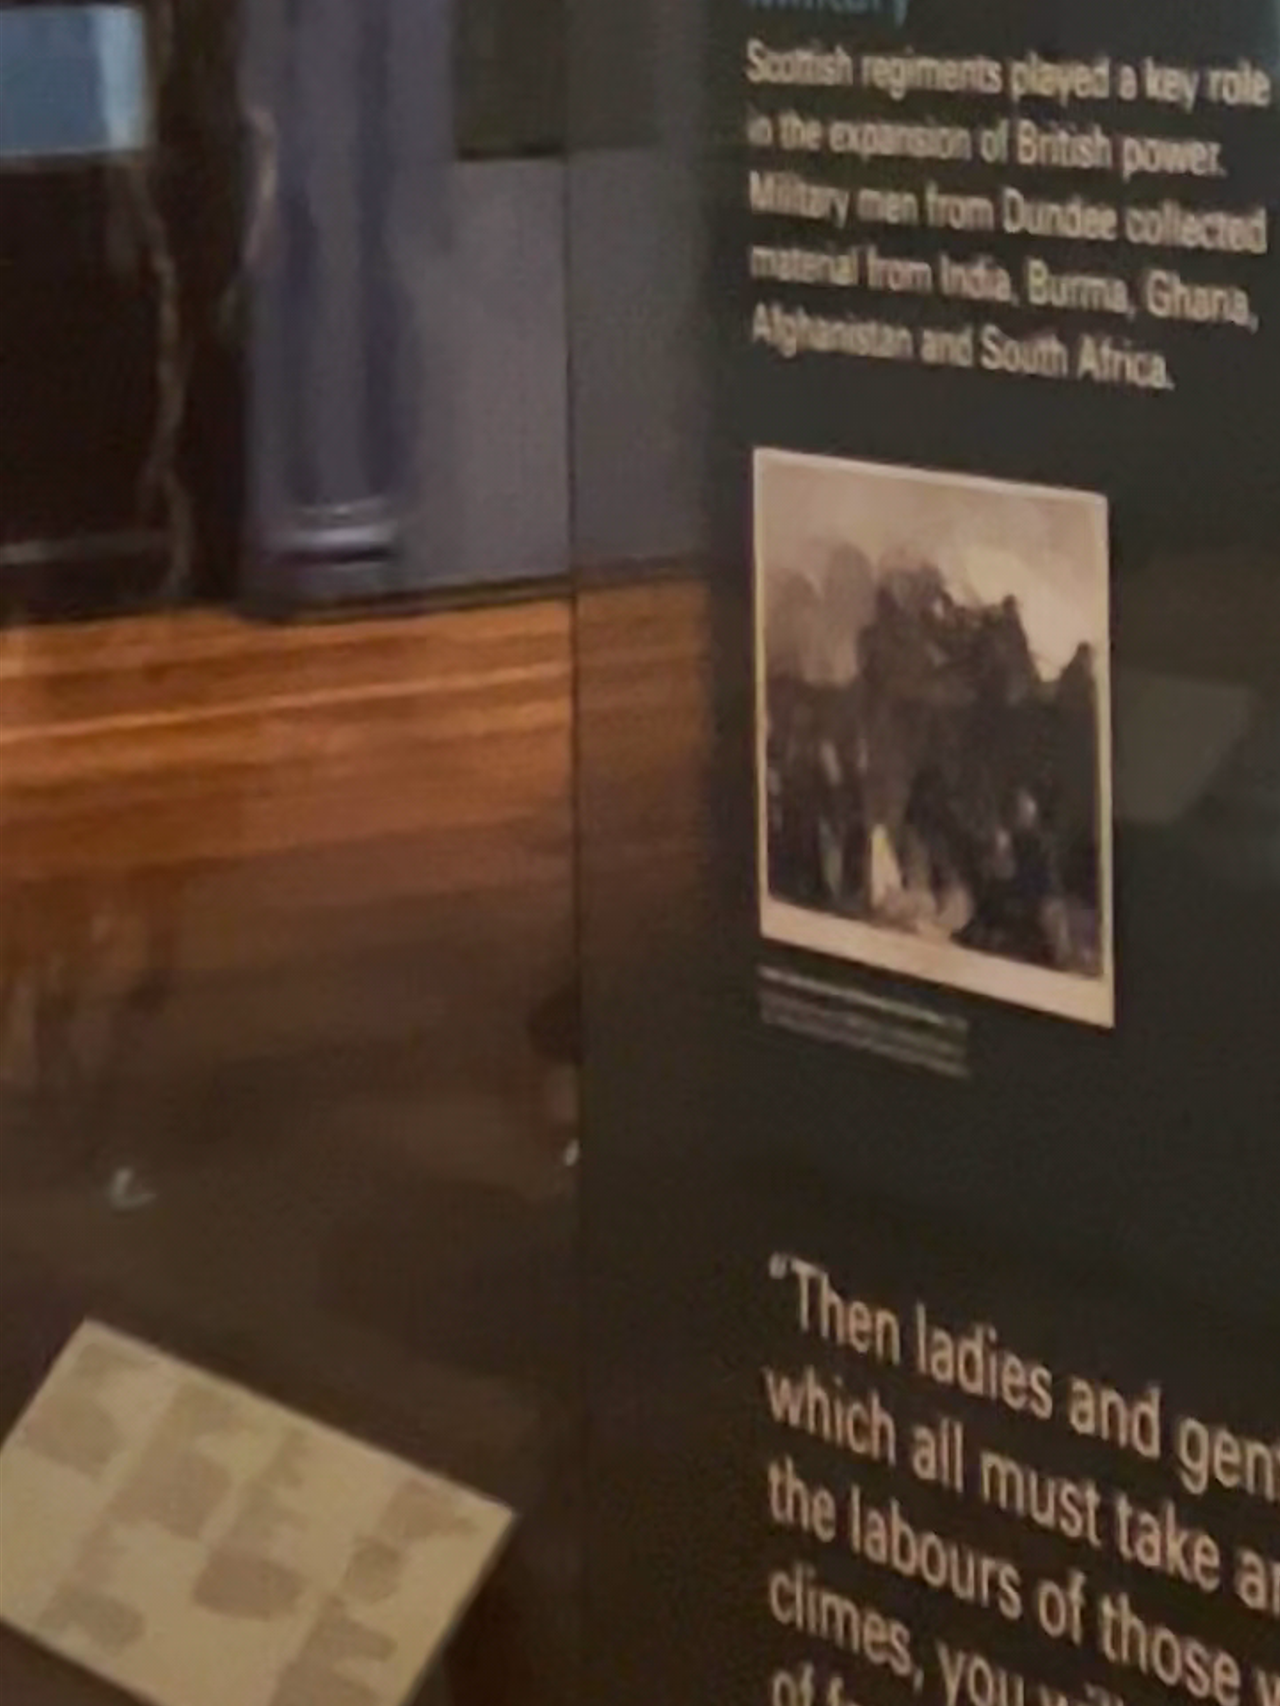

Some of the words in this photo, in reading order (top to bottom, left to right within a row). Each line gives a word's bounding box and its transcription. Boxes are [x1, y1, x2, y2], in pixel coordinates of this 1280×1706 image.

[746, 39, 853, 85] Scottish
[862, 49, 1001, 99] regiments
[1011, 51, 1109, 105] played
[1118, 65, 1137, 99] a
[1144, 57, 1198, 111] key
[1208, 60, 1271, 106] role
[781, 115, 822, 152] the
[829, 119, 972, 163] expansion
[981, 119, 1008, 161] of
[1018, 119, 1112, 169] British
[1123, 136, 1227, 182] power.
[749, 171, 850, 228] Military
[857, 190, 917, 225] men
[925, 182, 994, 230] from
[1004, 187, 1118, 241] Dundee
[1126, 201, 1268, 254] collected
[750, 244, 859, 285] material
[867, 247, 932, 291] from
[940, 254, 1019, 304] India,
[1028, 260, 1135, 319] Burma,
[1147, 269, 1259, 334] Ghana,
[753, 302, 913, 358] Afghanistan
[922, 324, 973, 368] and
[981, 326, 1068, 377] South
[1077, 334, 1175, 390] Africa.
[915, 1301, 1052, 1420] ladies
[1068, 1376, 1161, 1460] and
[764, 1365, 896, 1467] which
[911, 1412, 964, 1492] all
[980, 1448, 1102, 1548] must
[1114, 1490, 1220, 1590] take
[768, 1455, 836, 1542] the
[851, 1484, 1021, 1623] labours
[1038, 1567, 1085, 1645] of
[768, 1557, 924, 1694] climes,
